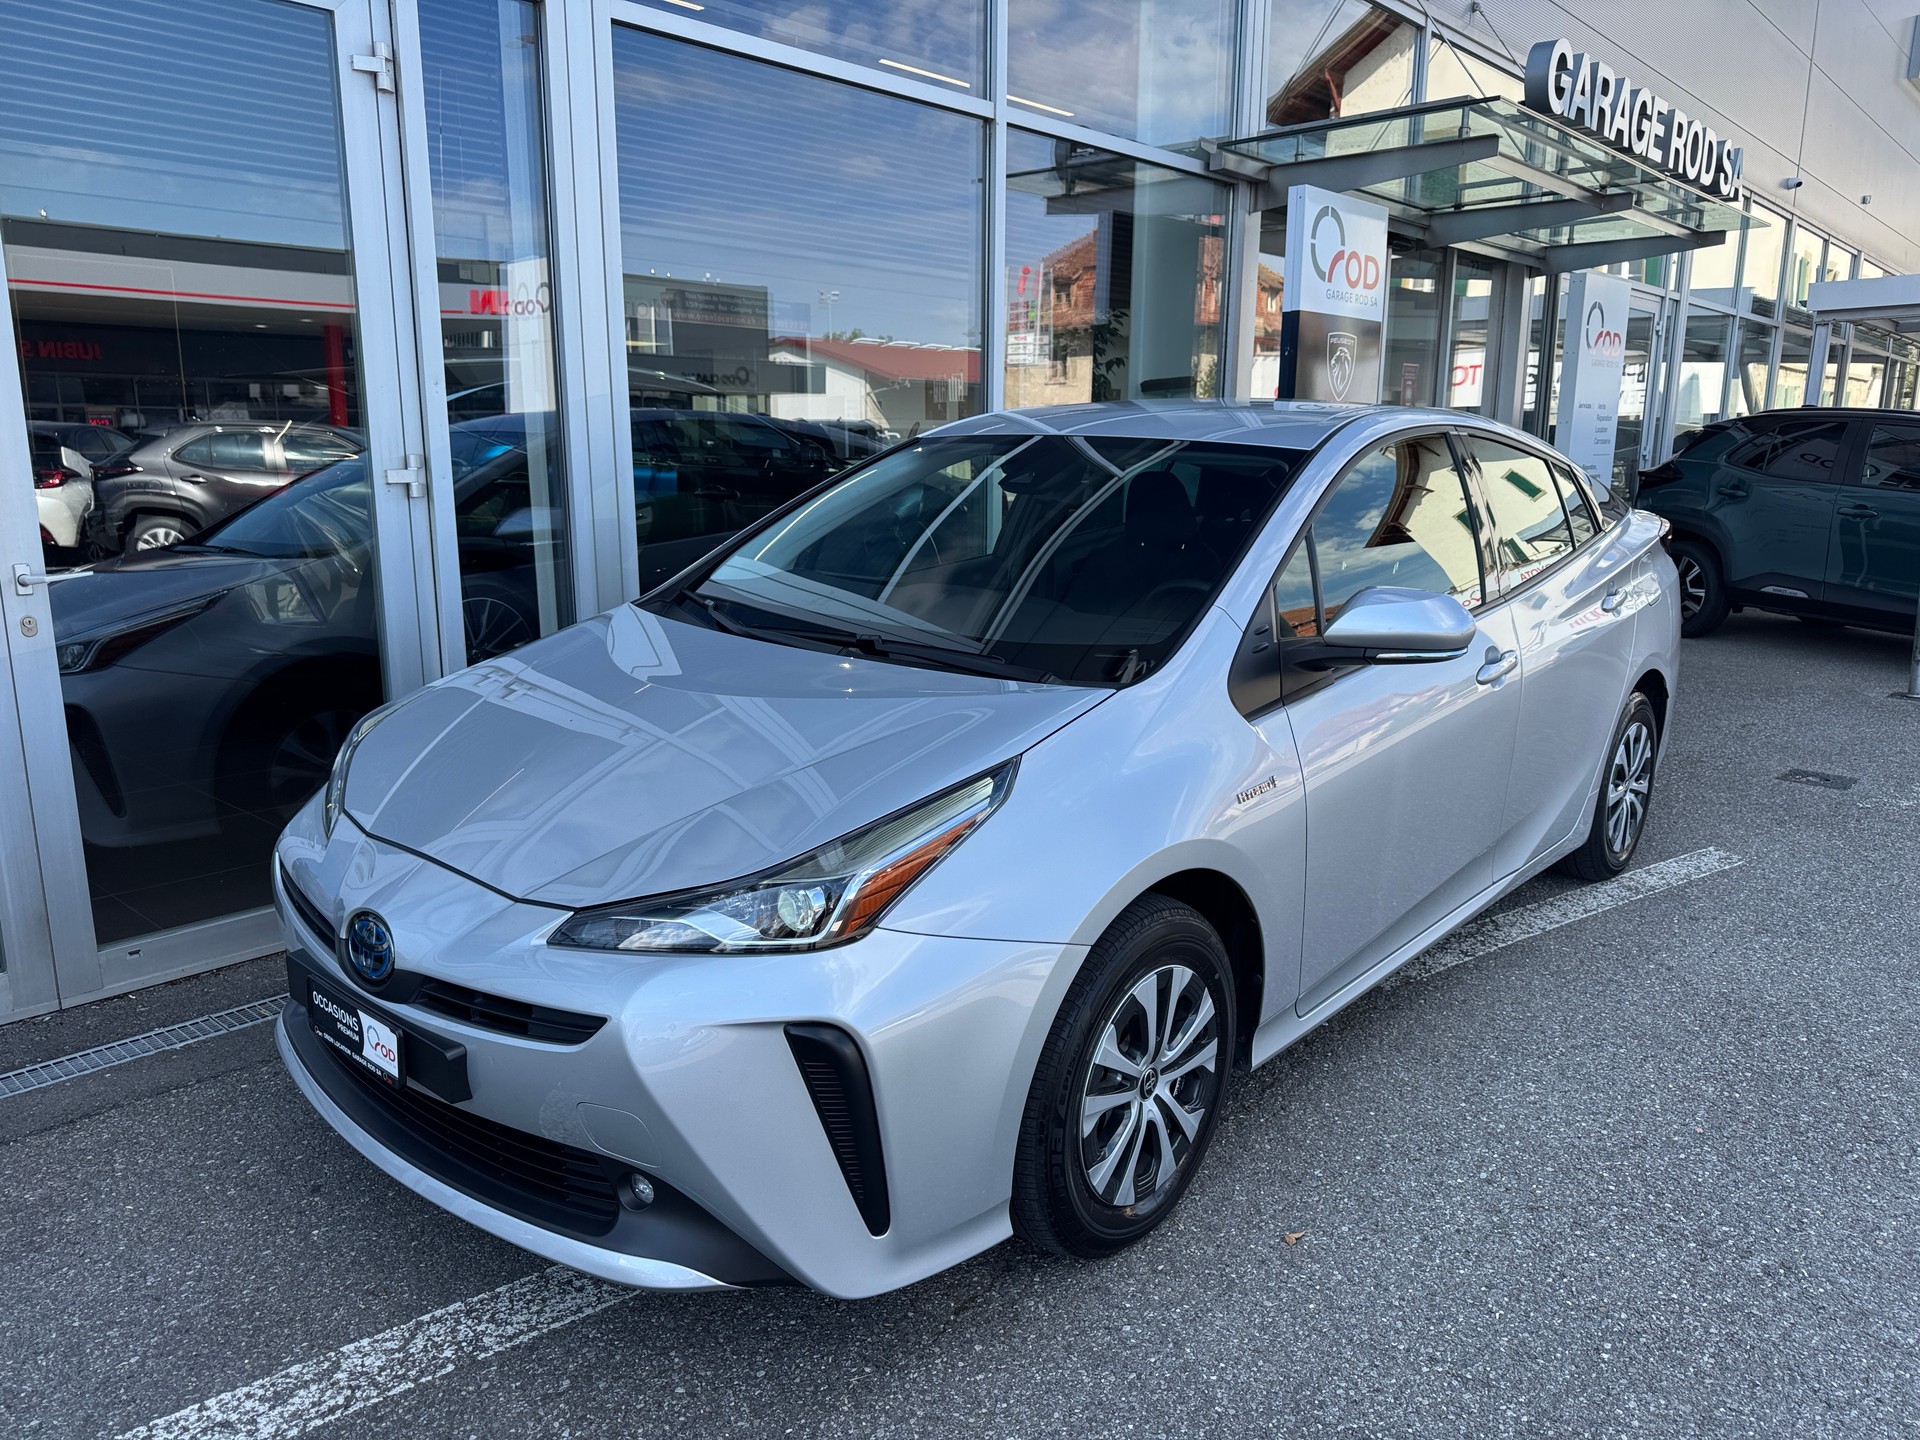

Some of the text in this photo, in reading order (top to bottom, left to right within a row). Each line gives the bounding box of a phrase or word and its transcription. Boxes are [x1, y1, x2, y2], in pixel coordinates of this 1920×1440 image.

[1546, 37, 1744, 200] GARAGE ROD SA
[1325, 288, 1378, 307] GARAGE ROD SA
[1329, 337, 1355, 346] PEUGEOT
[312, 990, 359, 1032] OCCASIONS
[336, 1021, 360, 1043] PREMIUM
[333, 1039, 352, 1056] LOCATION
[352, 1051, 368, 1067] GARAGE
